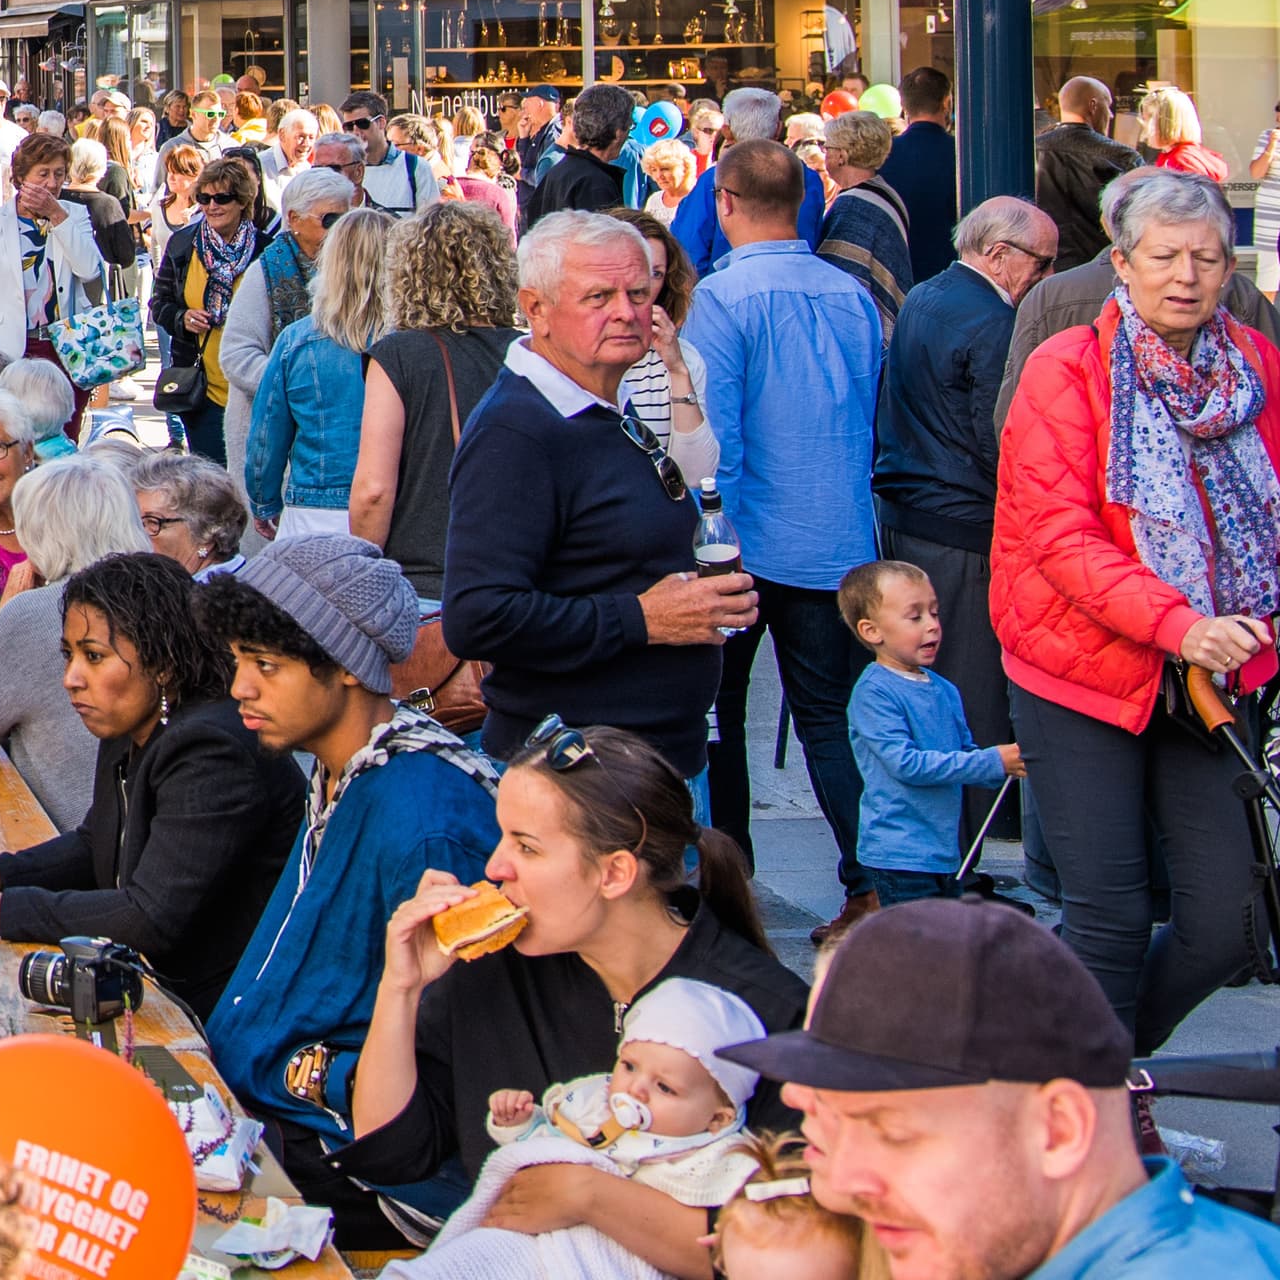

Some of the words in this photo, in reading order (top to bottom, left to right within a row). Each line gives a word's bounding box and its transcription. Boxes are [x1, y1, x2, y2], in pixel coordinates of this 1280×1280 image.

[8, 1175, 139, 1252] RYGGHET
[12, 1138, 112, 1201] FRIHET
[108, 1179, 150, 1222] OG
[57, 1231, 117, 1279] ALLE
